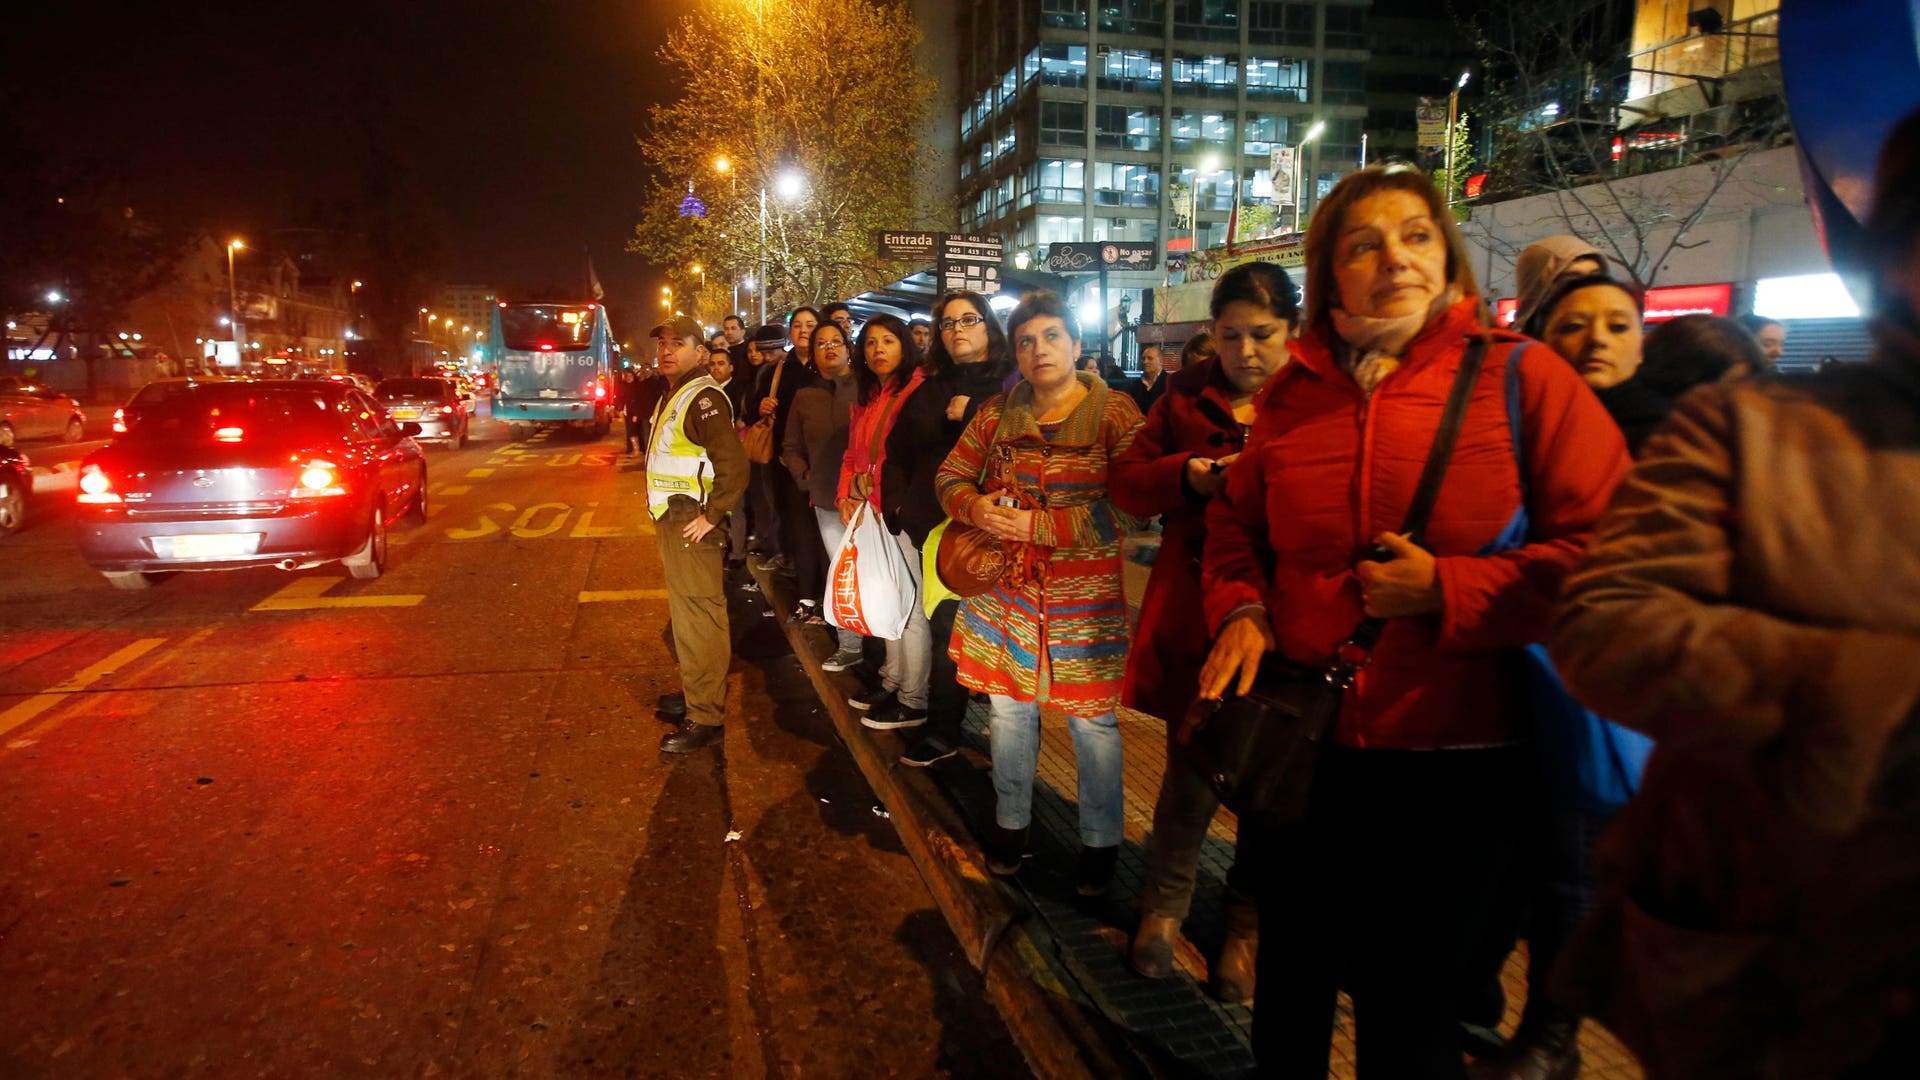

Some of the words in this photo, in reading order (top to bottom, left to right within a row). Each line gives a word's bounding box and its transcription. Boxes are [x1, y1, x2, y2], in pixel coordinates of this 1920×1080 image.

[883, 234, 933, 246] Entrada
[1119, 248, 1130, 256] No
[1131, 249, 1153, 257] pasar
[578, 355, 594, 367] 60
